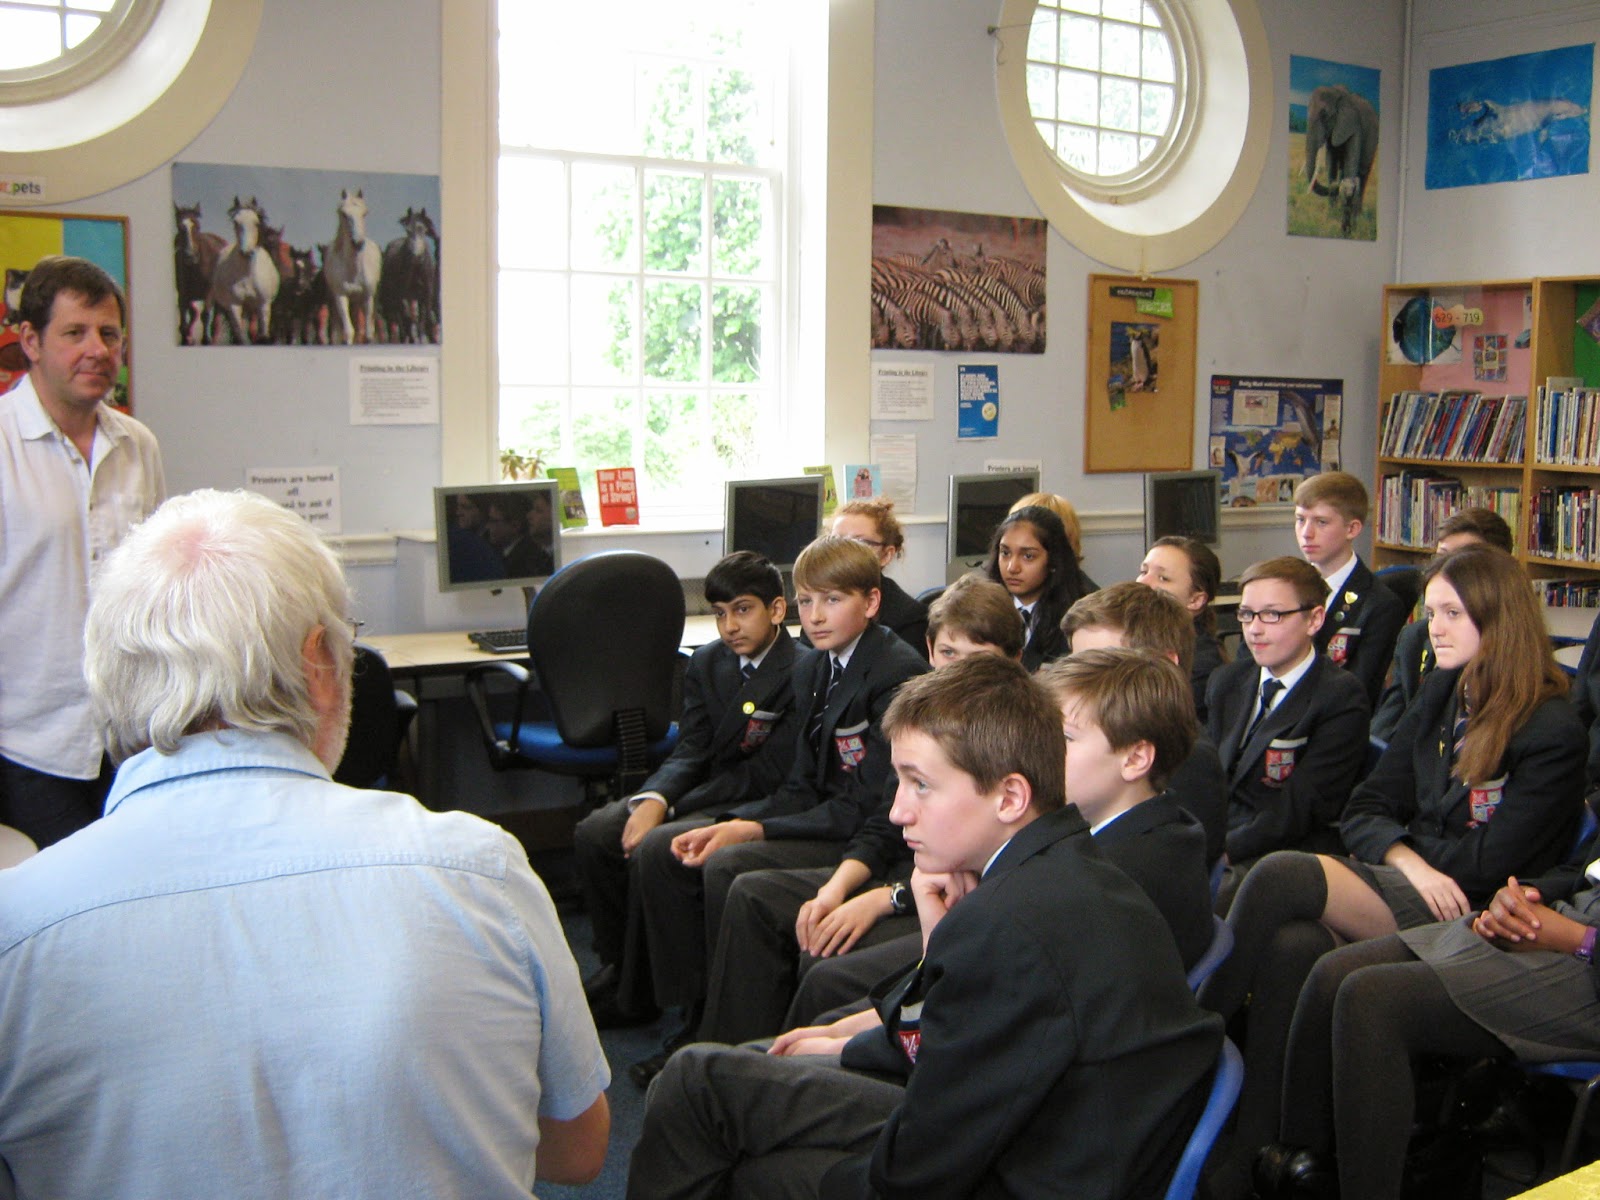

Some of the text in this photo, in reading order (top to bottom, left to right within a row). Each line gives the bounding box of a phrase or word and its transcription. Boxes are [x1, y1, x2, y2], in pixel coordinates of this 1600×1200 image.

[12, 181, 41, 196] pets
[1435, 312, 1453, 323] 629
[1463, 312, 1480, 323] 719
[251, 475, 287, 484] Printers
[306, 473, 334, 482] turned
